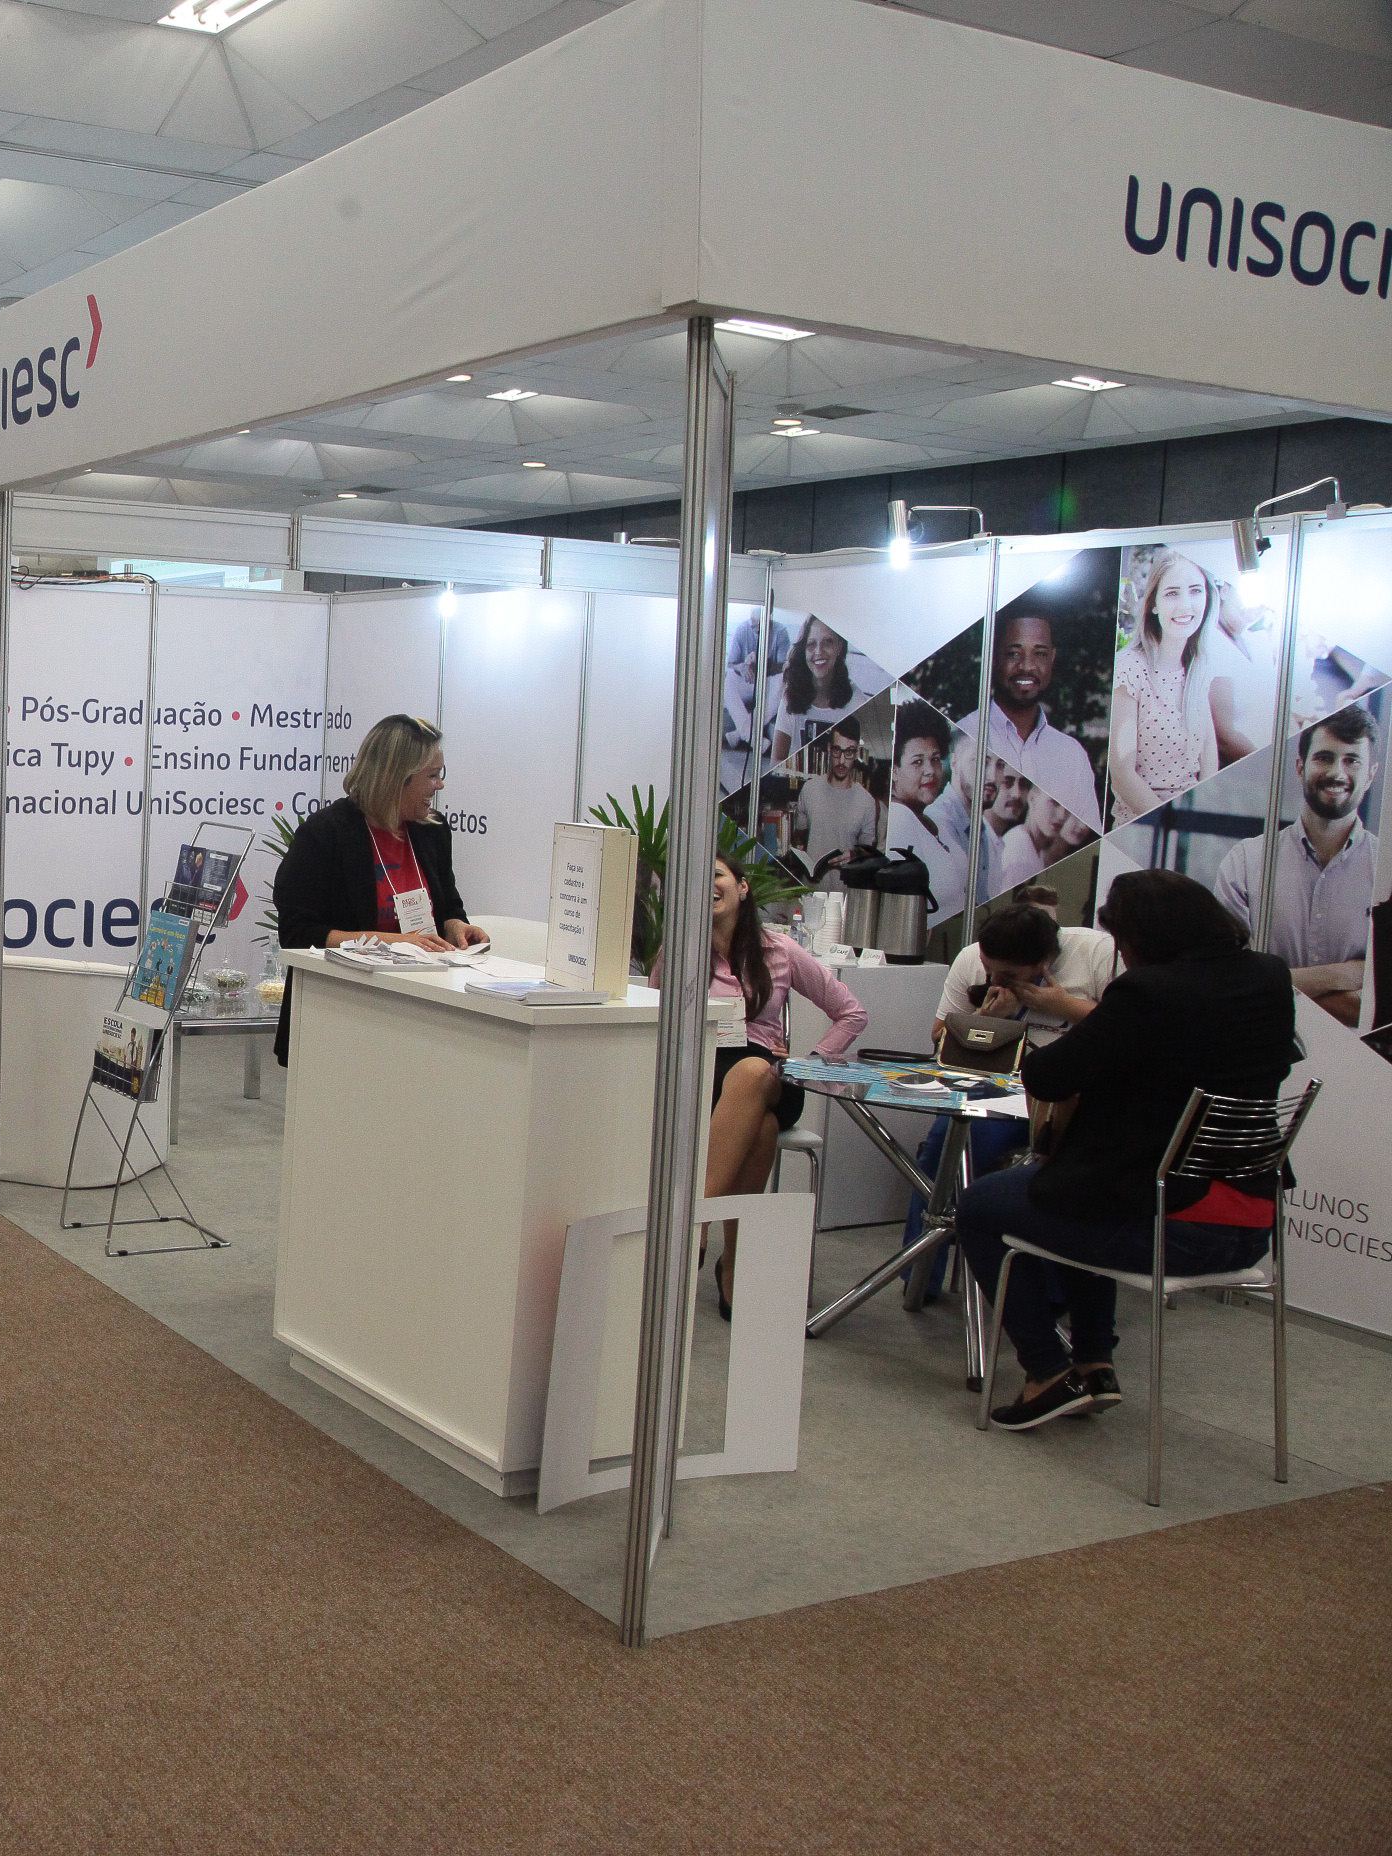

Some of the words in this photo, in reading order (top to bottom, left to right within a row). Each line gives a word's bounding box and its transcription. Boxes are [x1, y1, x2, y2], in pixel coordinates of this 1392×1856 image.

[250, 703, 352, 730] Mestrado
[50, 742, 115, 776] Tupy
[151, 745, 231, 771] Ensino
[126, 789, 265, 816] UniSociesc
[103, 1016, 123, 1030] ESCOLA
[1283, 1215, 1392, 1262] NISOCIES
